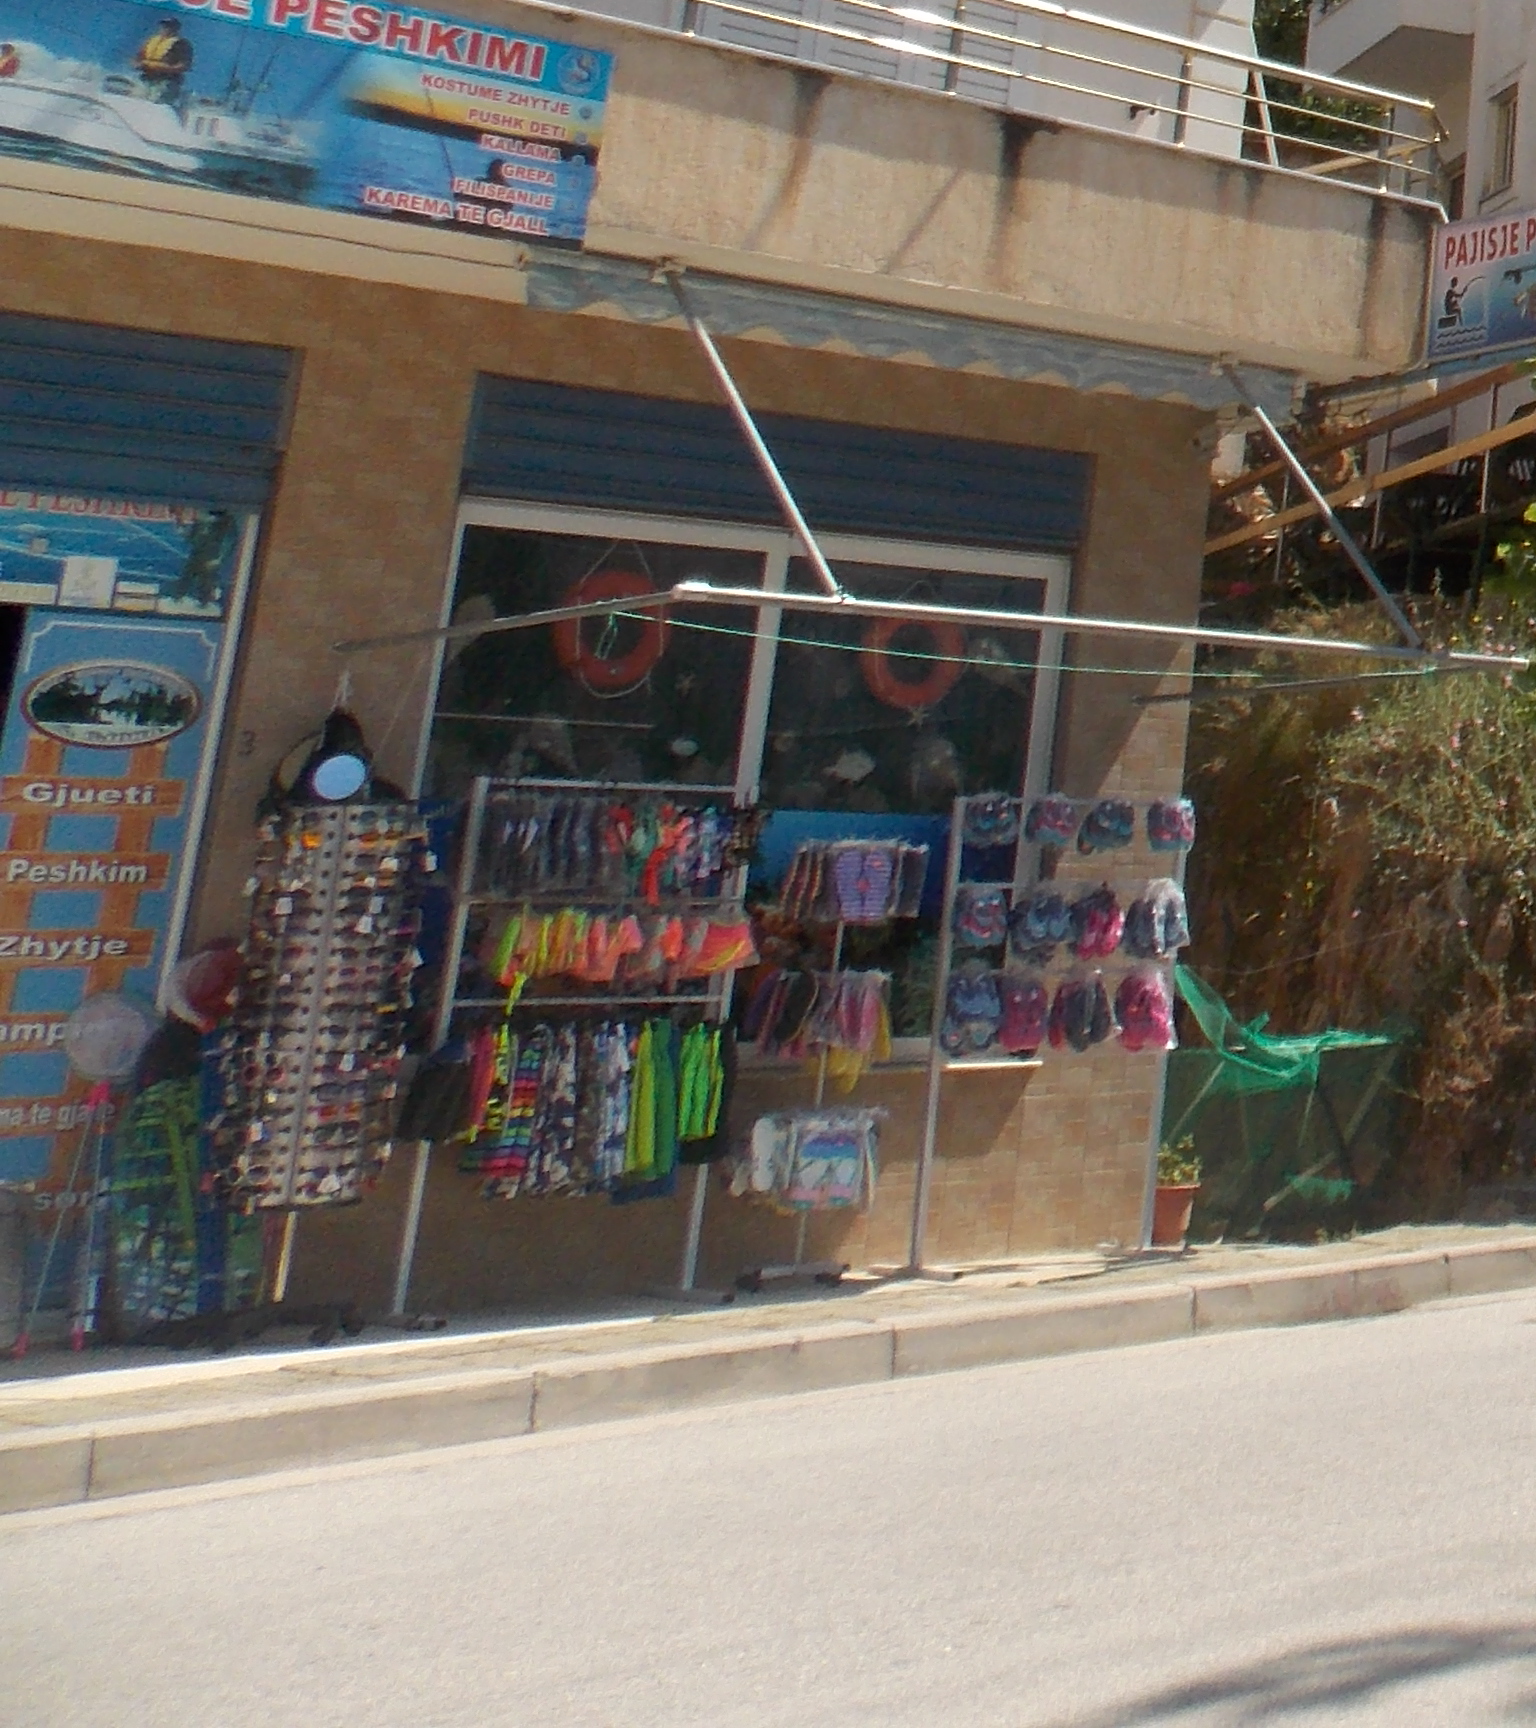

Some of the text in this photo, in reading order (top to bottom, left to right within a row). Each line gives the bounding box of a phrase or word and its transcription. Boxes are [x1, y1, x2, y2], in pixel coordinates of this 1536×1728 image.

[421, 74, 570, 116] KOSTUME ZHYTJE
[468, 108, 566, 138] PUSHK DETI
[481, 134, 561, 162] KALLAMA
[502, 164, 557, 185] GREPA
[455, 178, 555, 208] FILISPANIJE
[366, 187, 548, 235] KAREMA TE GJALL
[1444, 222, 1519, 269] PAJISJE
[22, 782, 155, 808] Gjueti
[6, 858, 147, 884] Peshkim
[0, 935, 128, 960] Zhytje
